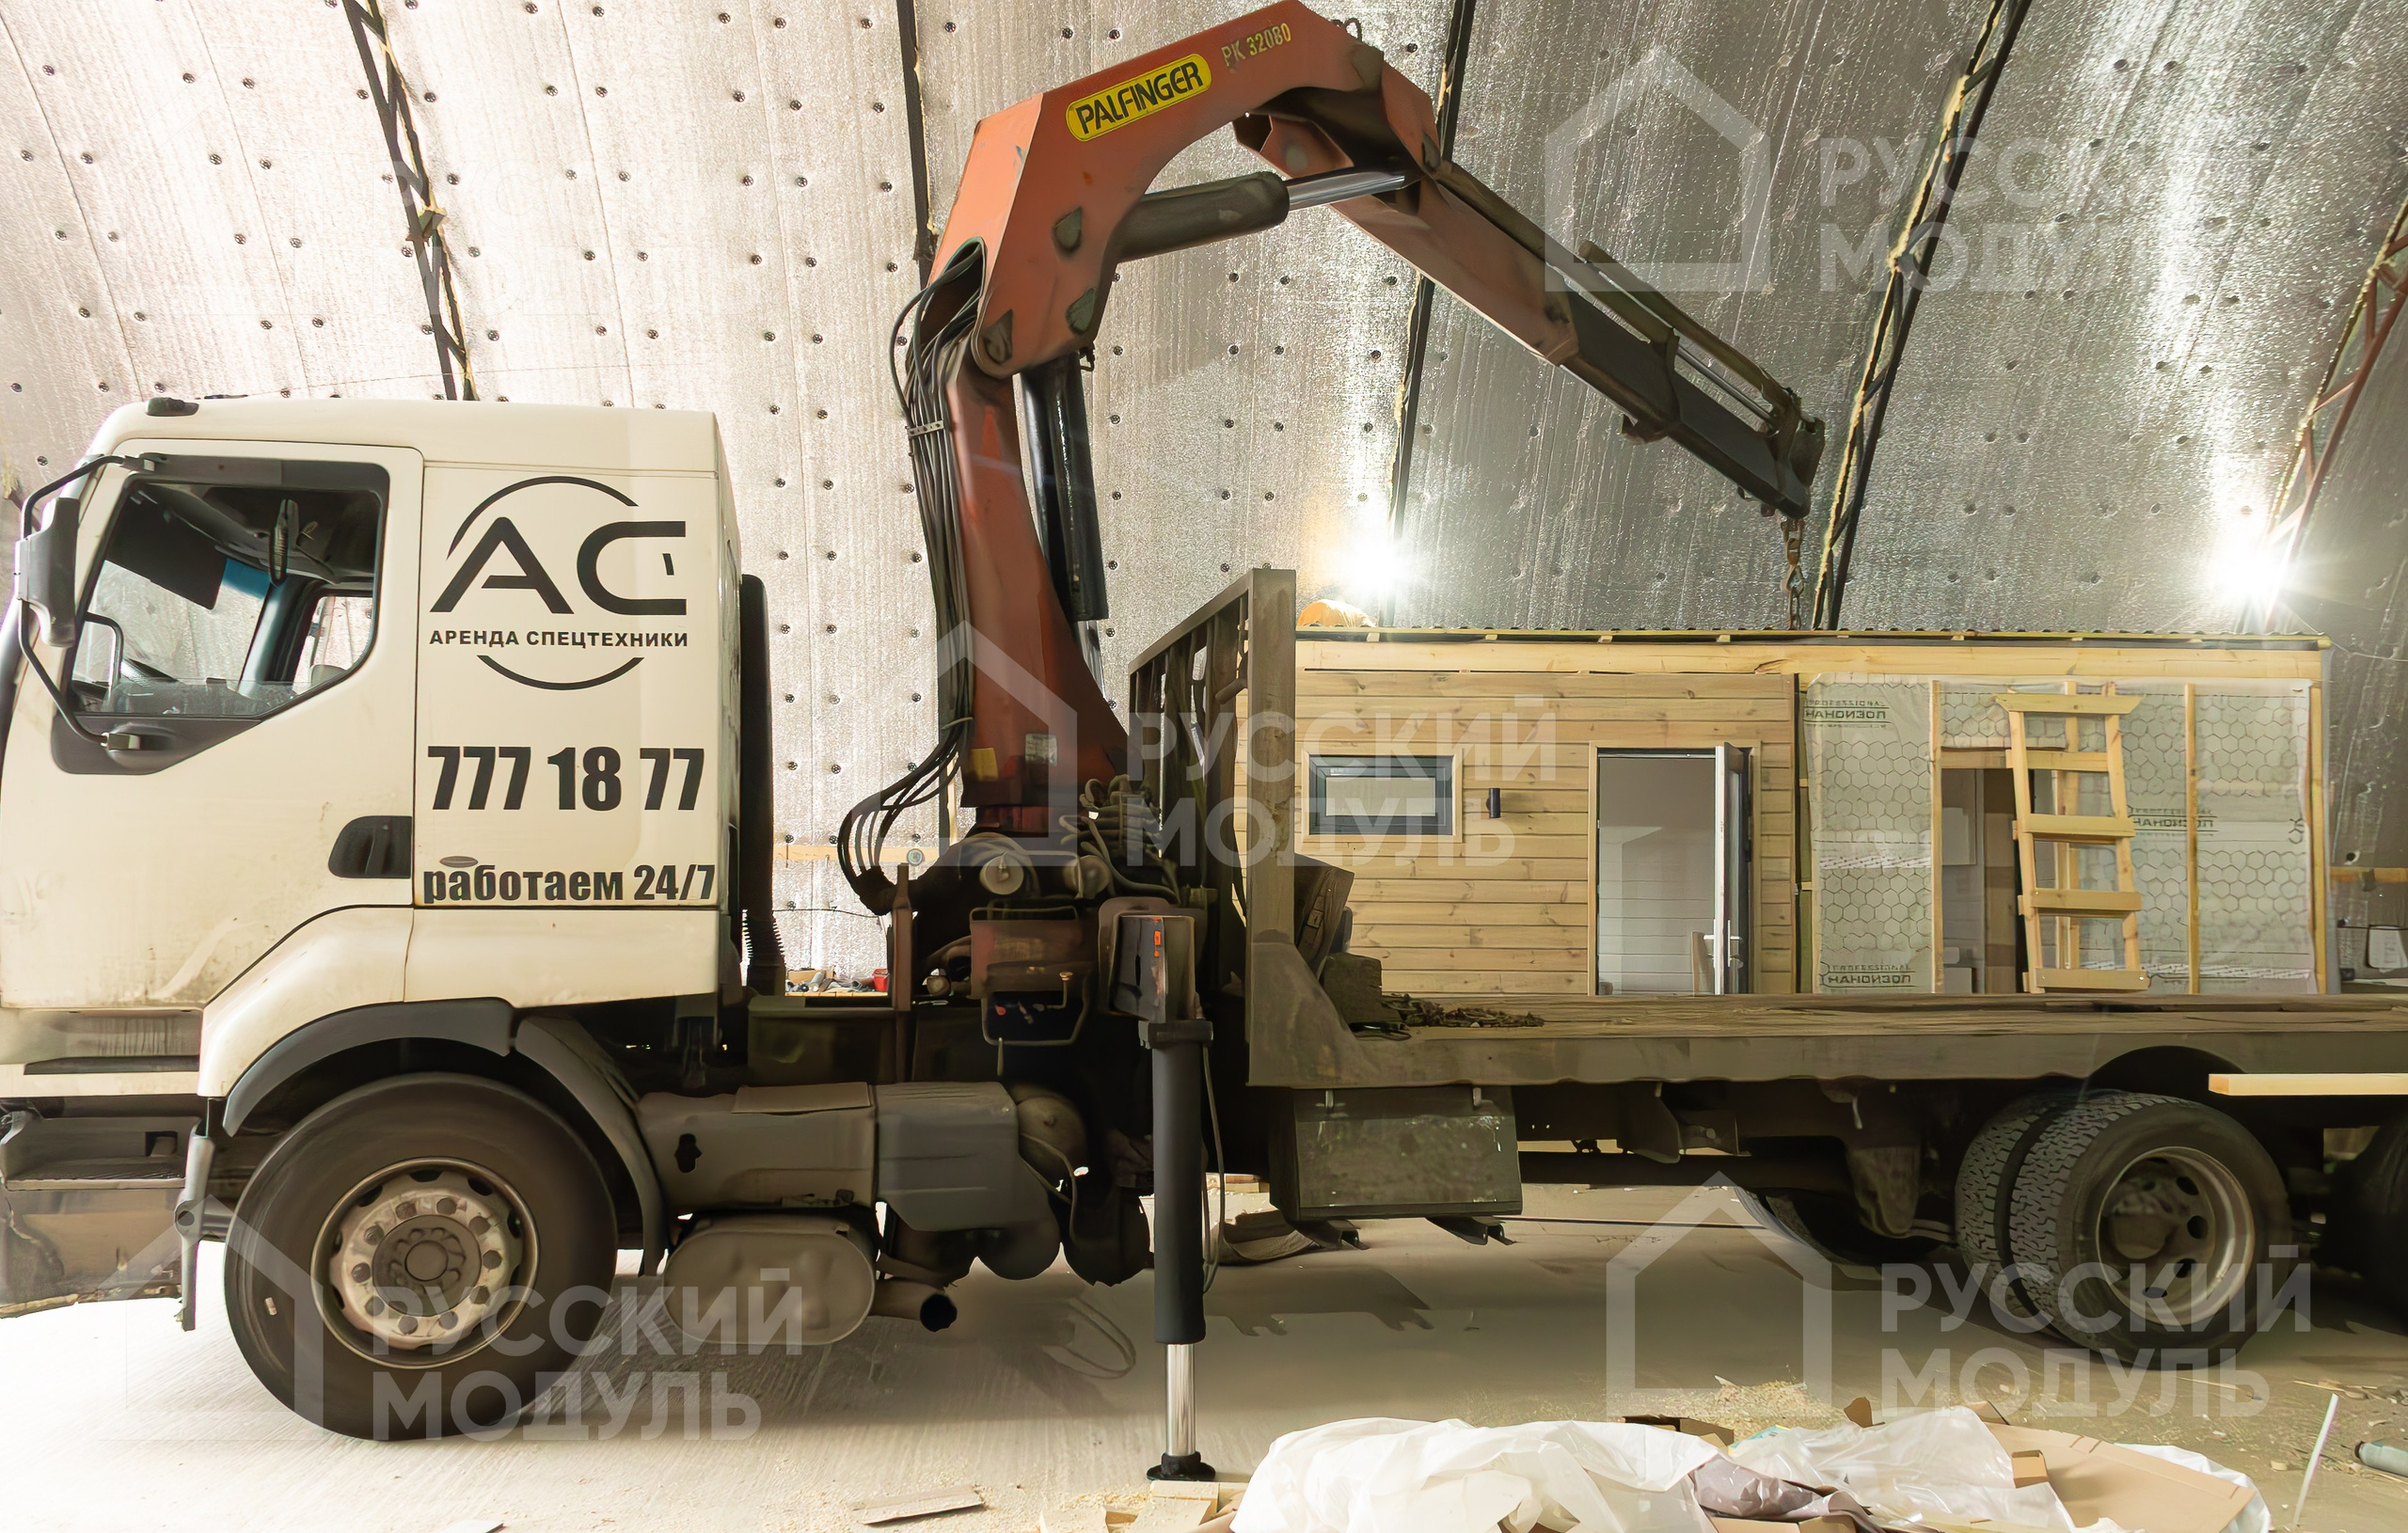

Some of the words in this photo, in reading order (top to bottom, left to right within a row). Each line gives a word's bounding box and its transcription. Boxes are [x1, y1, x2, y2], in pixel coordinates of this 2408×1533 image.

[1221, 40, 1246, 67] PK
[1246, 23, 1291, 56] 32080
[1076, 60, 1204, 134] PALFINGER
[429, 630, 520, 647] АРЕНДА
[527, 630, 689, 650] СПЕЦТЕХНИКИ
[428, 746, 531, 810] 777
[547, 746, 622, 811] 18
[640, 748, 705, 811] 77
[423, 864, 624, 904] работаем
[633, 864, 715, 901] 24/7
